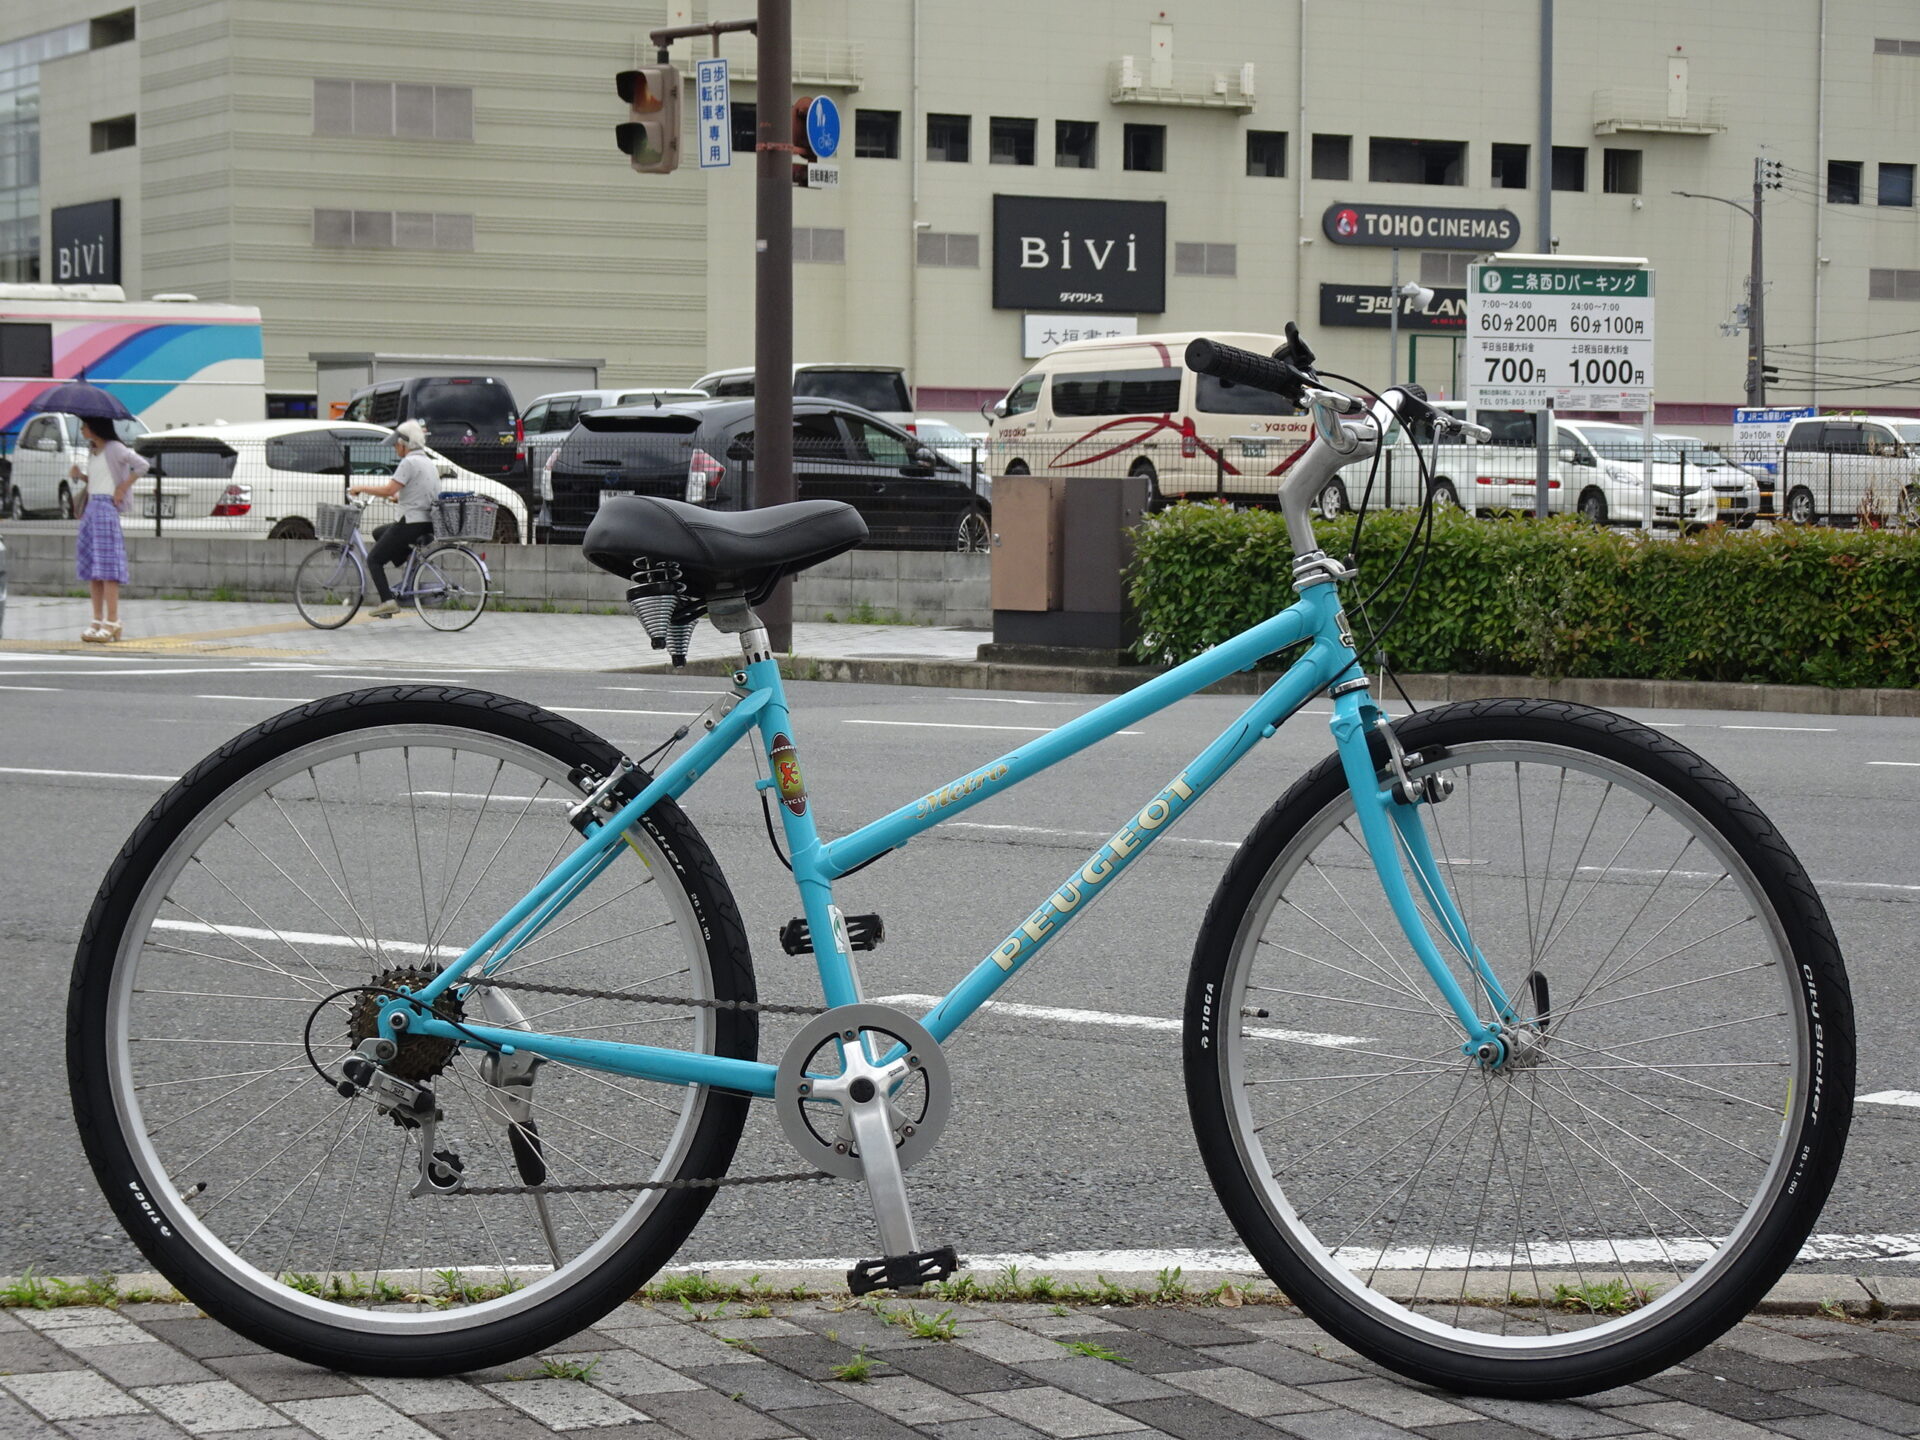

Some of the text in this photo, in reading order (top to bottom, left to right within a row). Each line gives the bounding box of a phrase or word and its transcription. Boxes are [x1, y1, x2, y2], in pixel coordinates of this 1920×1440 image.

[701, 68, 713, 121] 自転車
[713, 66, 725, 120] 歩行者
[709, 125, 721, 161] 専用
[1365, 214, 1510, 239] TOHO CINEMAS
[1511, 272, 1637, 292] 二条西Dパーキング
[1336, 295, 1355, 303] THE
[1481, 313, 1557, 332] 60分200円
[1570, 315, 1644, 334] 60分100円
[1484, 357, 1546, 383] 700円
[1569, 359, 1644, 386] 1,000円
[999, 428, 1027, 438] yasaka
[1265, 422, 1307, 432] yasaka
[991, 772, 1195, 972] PEUGEOT
[1202, 982, 1214, 1031] TIOGA
[129, 1181, 160, 1224] TIOGA
